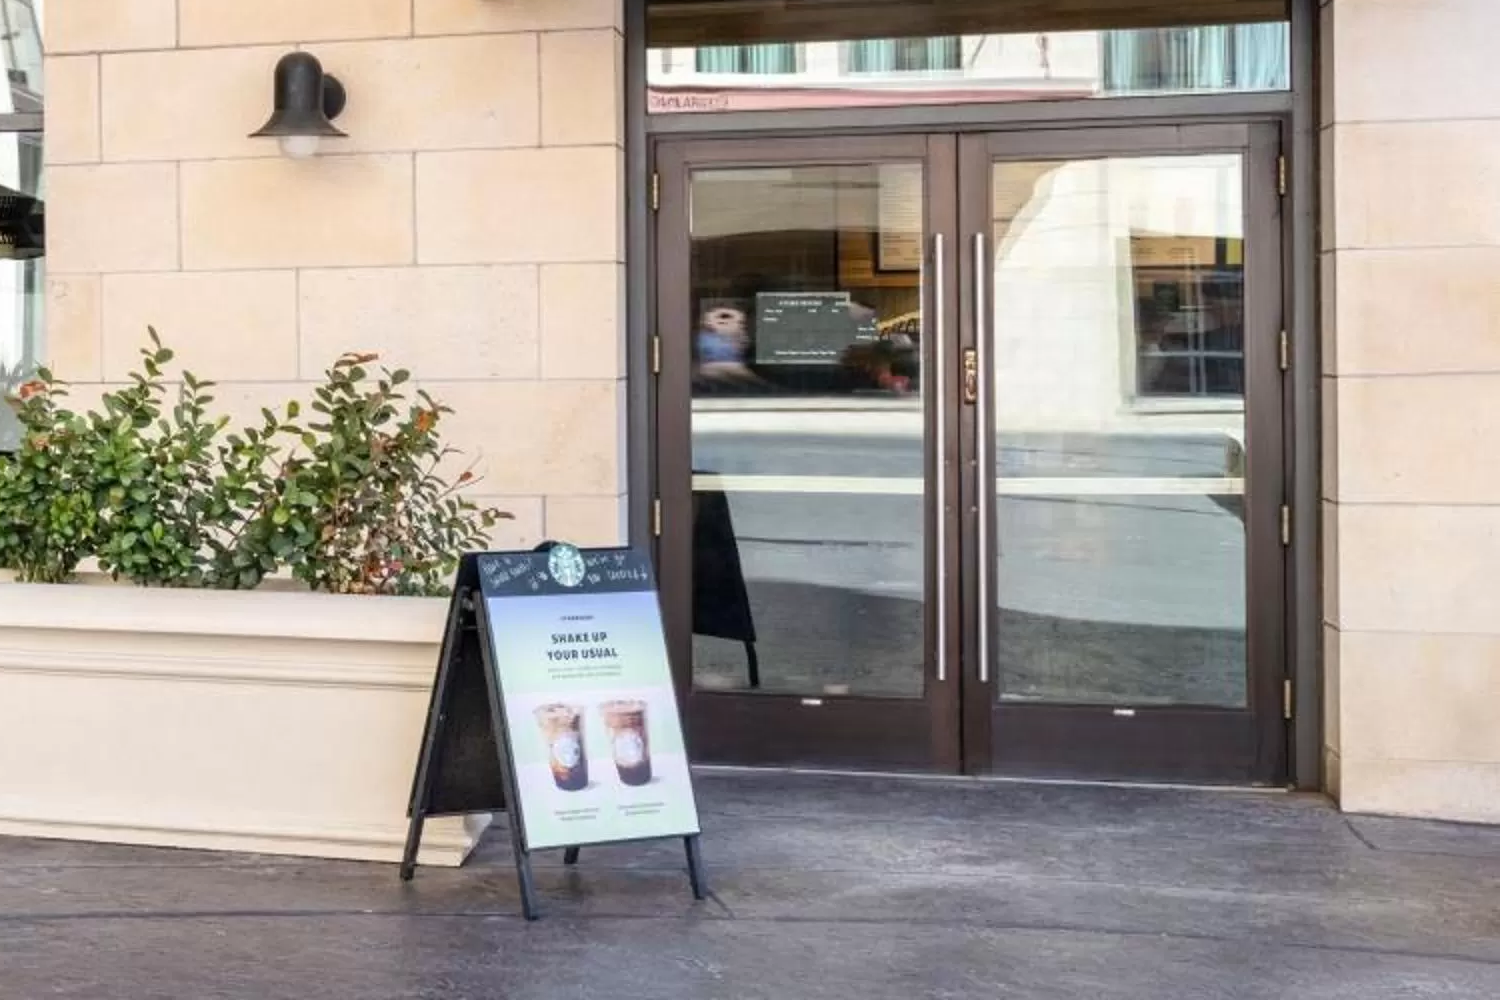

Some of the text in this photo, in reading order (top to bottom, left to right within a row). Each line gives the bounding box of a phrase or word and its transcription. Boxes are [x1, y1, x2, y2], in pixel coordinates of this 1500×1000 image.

[551, 631, 607, 645] SHAKE UP
[547, 647, 619, 661] YOUR USUAL
